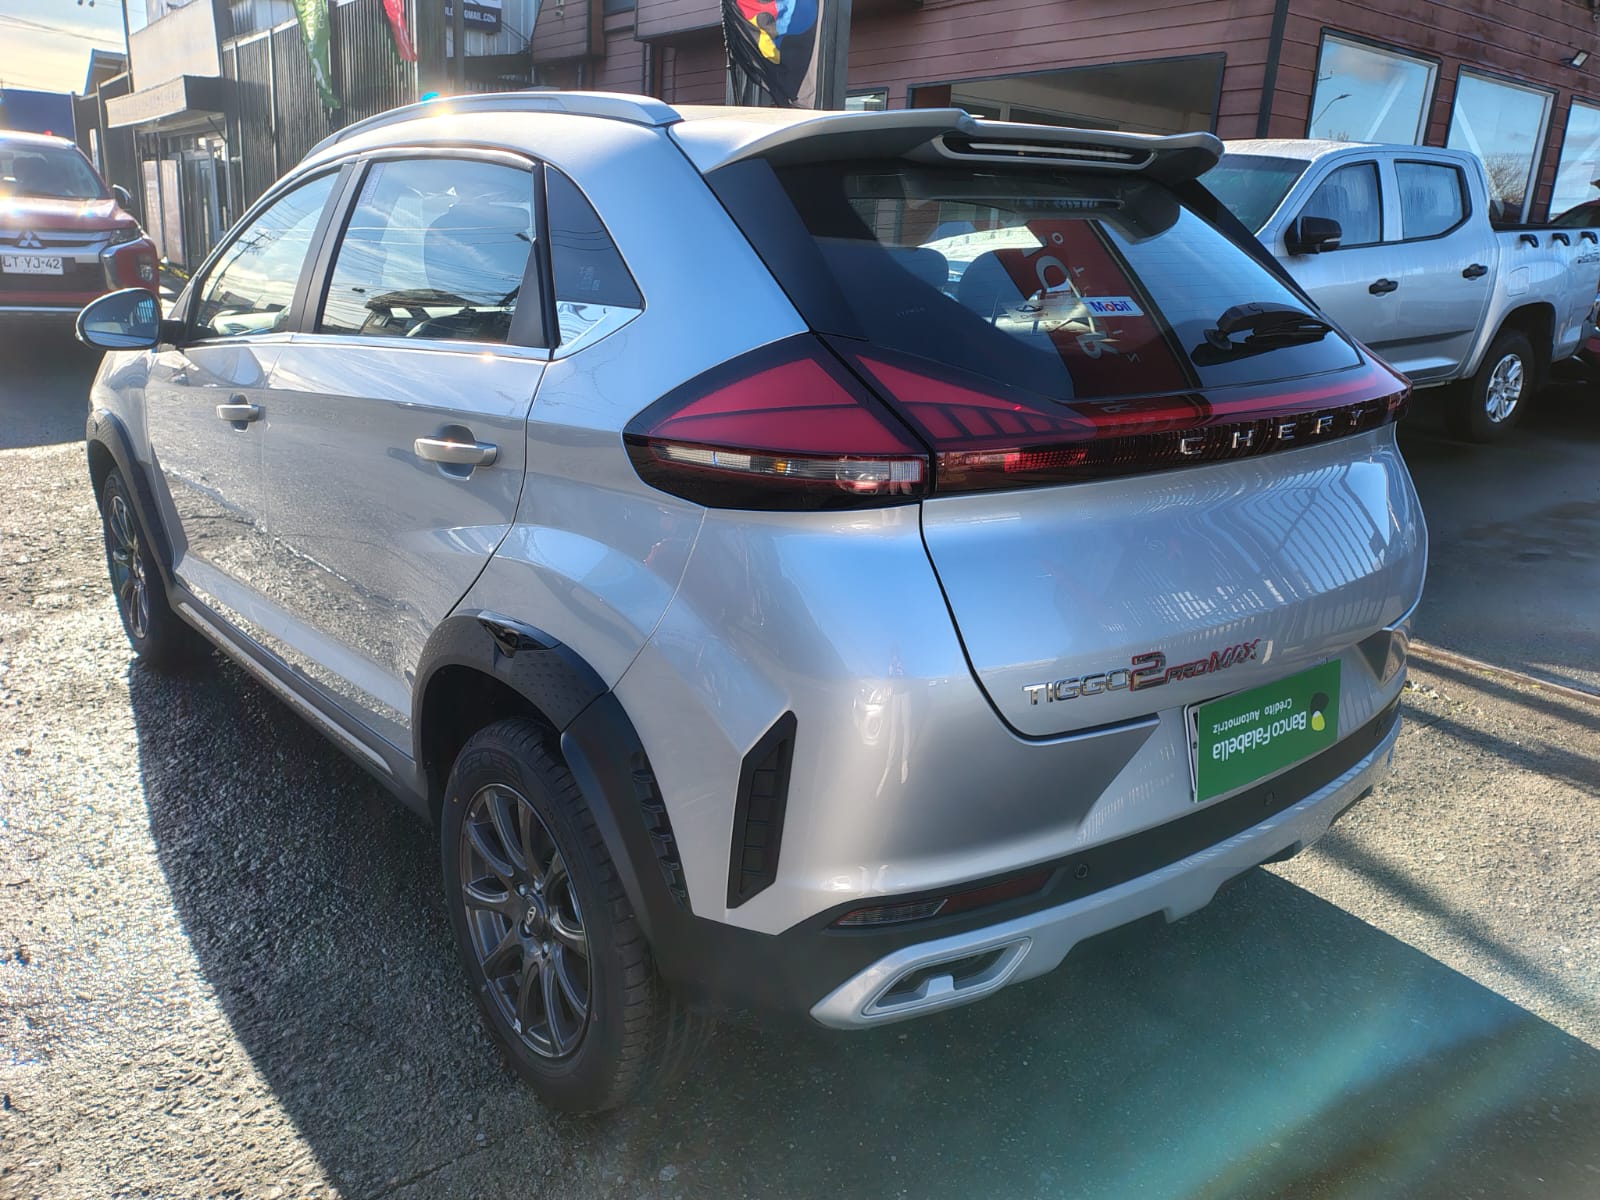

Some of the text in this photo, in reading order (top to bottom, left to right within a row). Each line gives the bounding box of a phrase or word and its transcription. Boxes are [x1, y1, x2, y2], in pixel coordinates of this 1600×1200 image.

[1090, 301, 1133, 313] Mobil
[1180, 409, 1364, 455] CHERY
[1212, 698, 1292, 735] Crédito Automotriz
[1212, 710, 1307, 761] Banco Falabella
